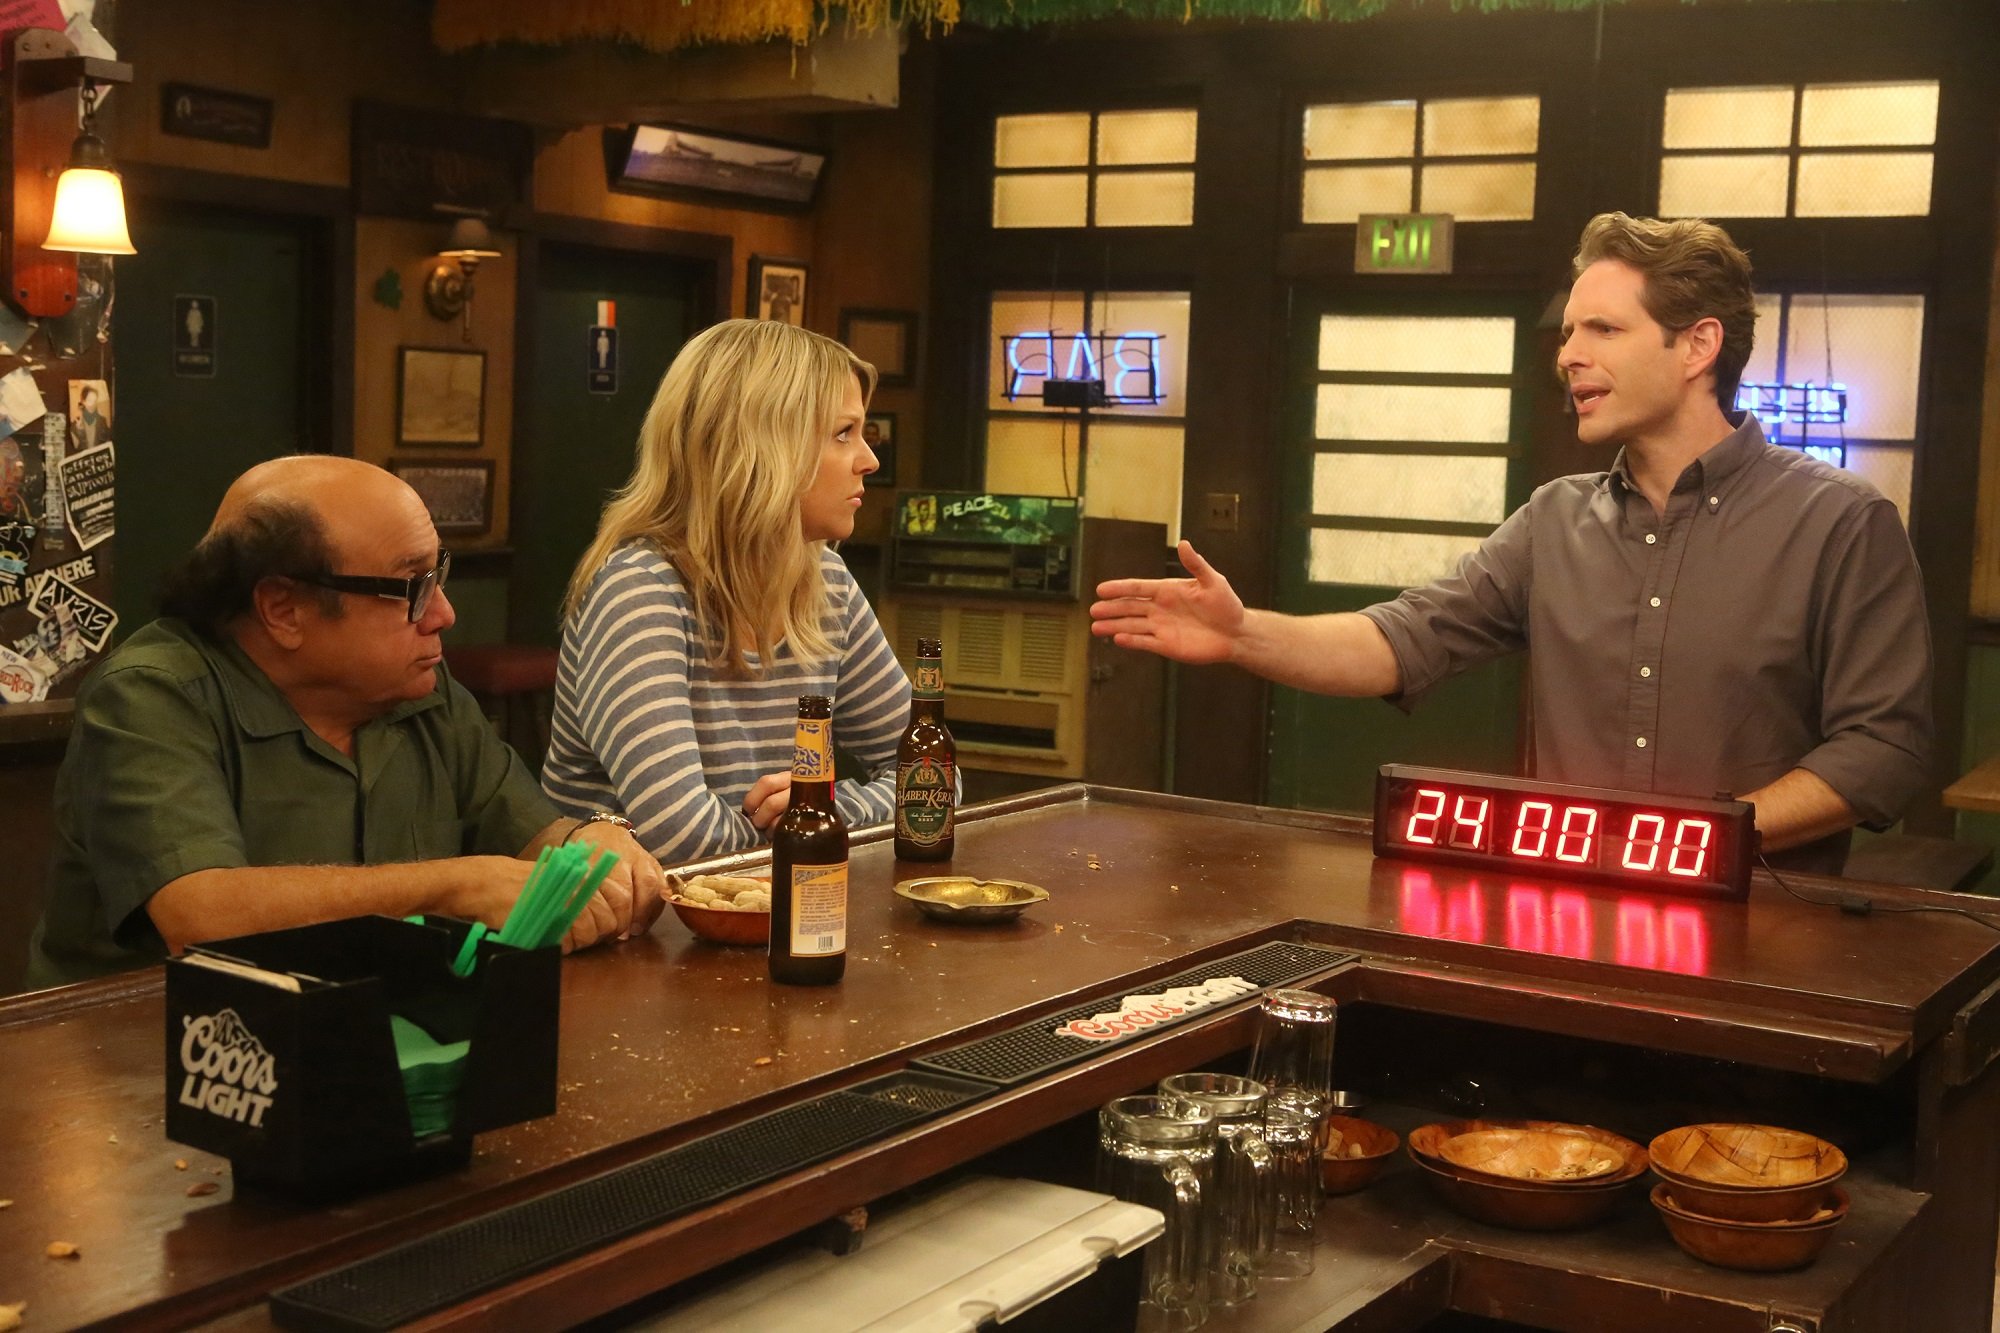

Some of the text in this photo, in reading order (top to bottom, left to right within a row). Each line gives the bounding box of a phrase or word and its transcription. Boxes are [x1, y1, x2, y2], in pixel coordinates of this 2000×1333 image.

[1372, 219, 1434, 266] EXIT
[1406, 789, 1712, 877] 24 00 00
[1056, 1002, 1185, 1040] Coors
[181, 1015, 278, 1095] Coors
[180, 1074, 274, 1127] LIGHT
